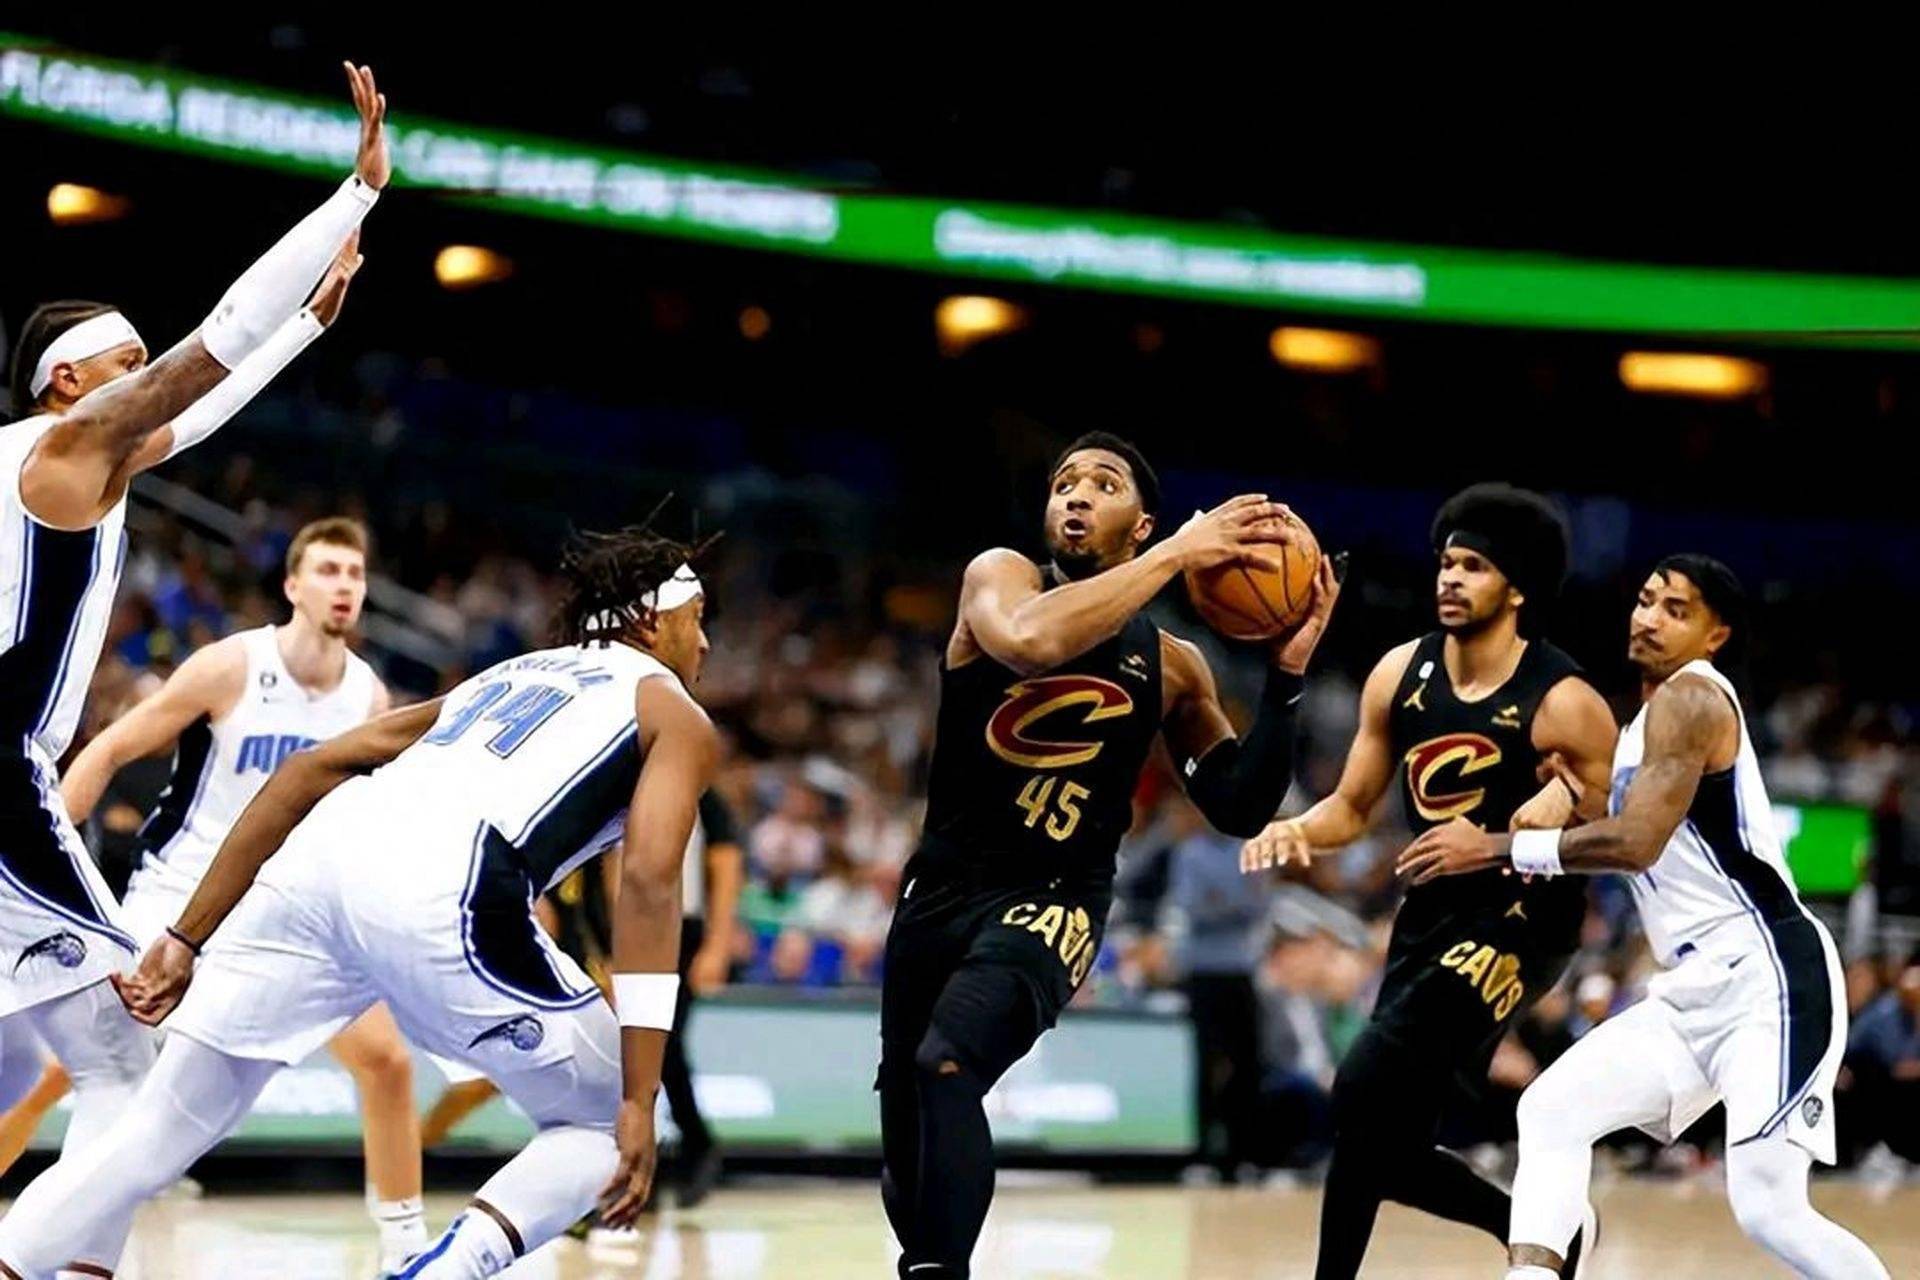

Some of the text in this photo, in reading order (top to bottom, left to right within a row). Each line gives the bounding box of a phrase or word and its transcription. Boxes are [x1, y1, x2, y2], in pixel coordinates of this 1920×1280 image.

[985, 674, 1133, 768] C
[1015, 775, 1091, 841] 45
[1404, 733, 1502, 821] C
[1002, 903, 1094, 987] CAVS
[1440, 940, 1523, 1021] CAVS
